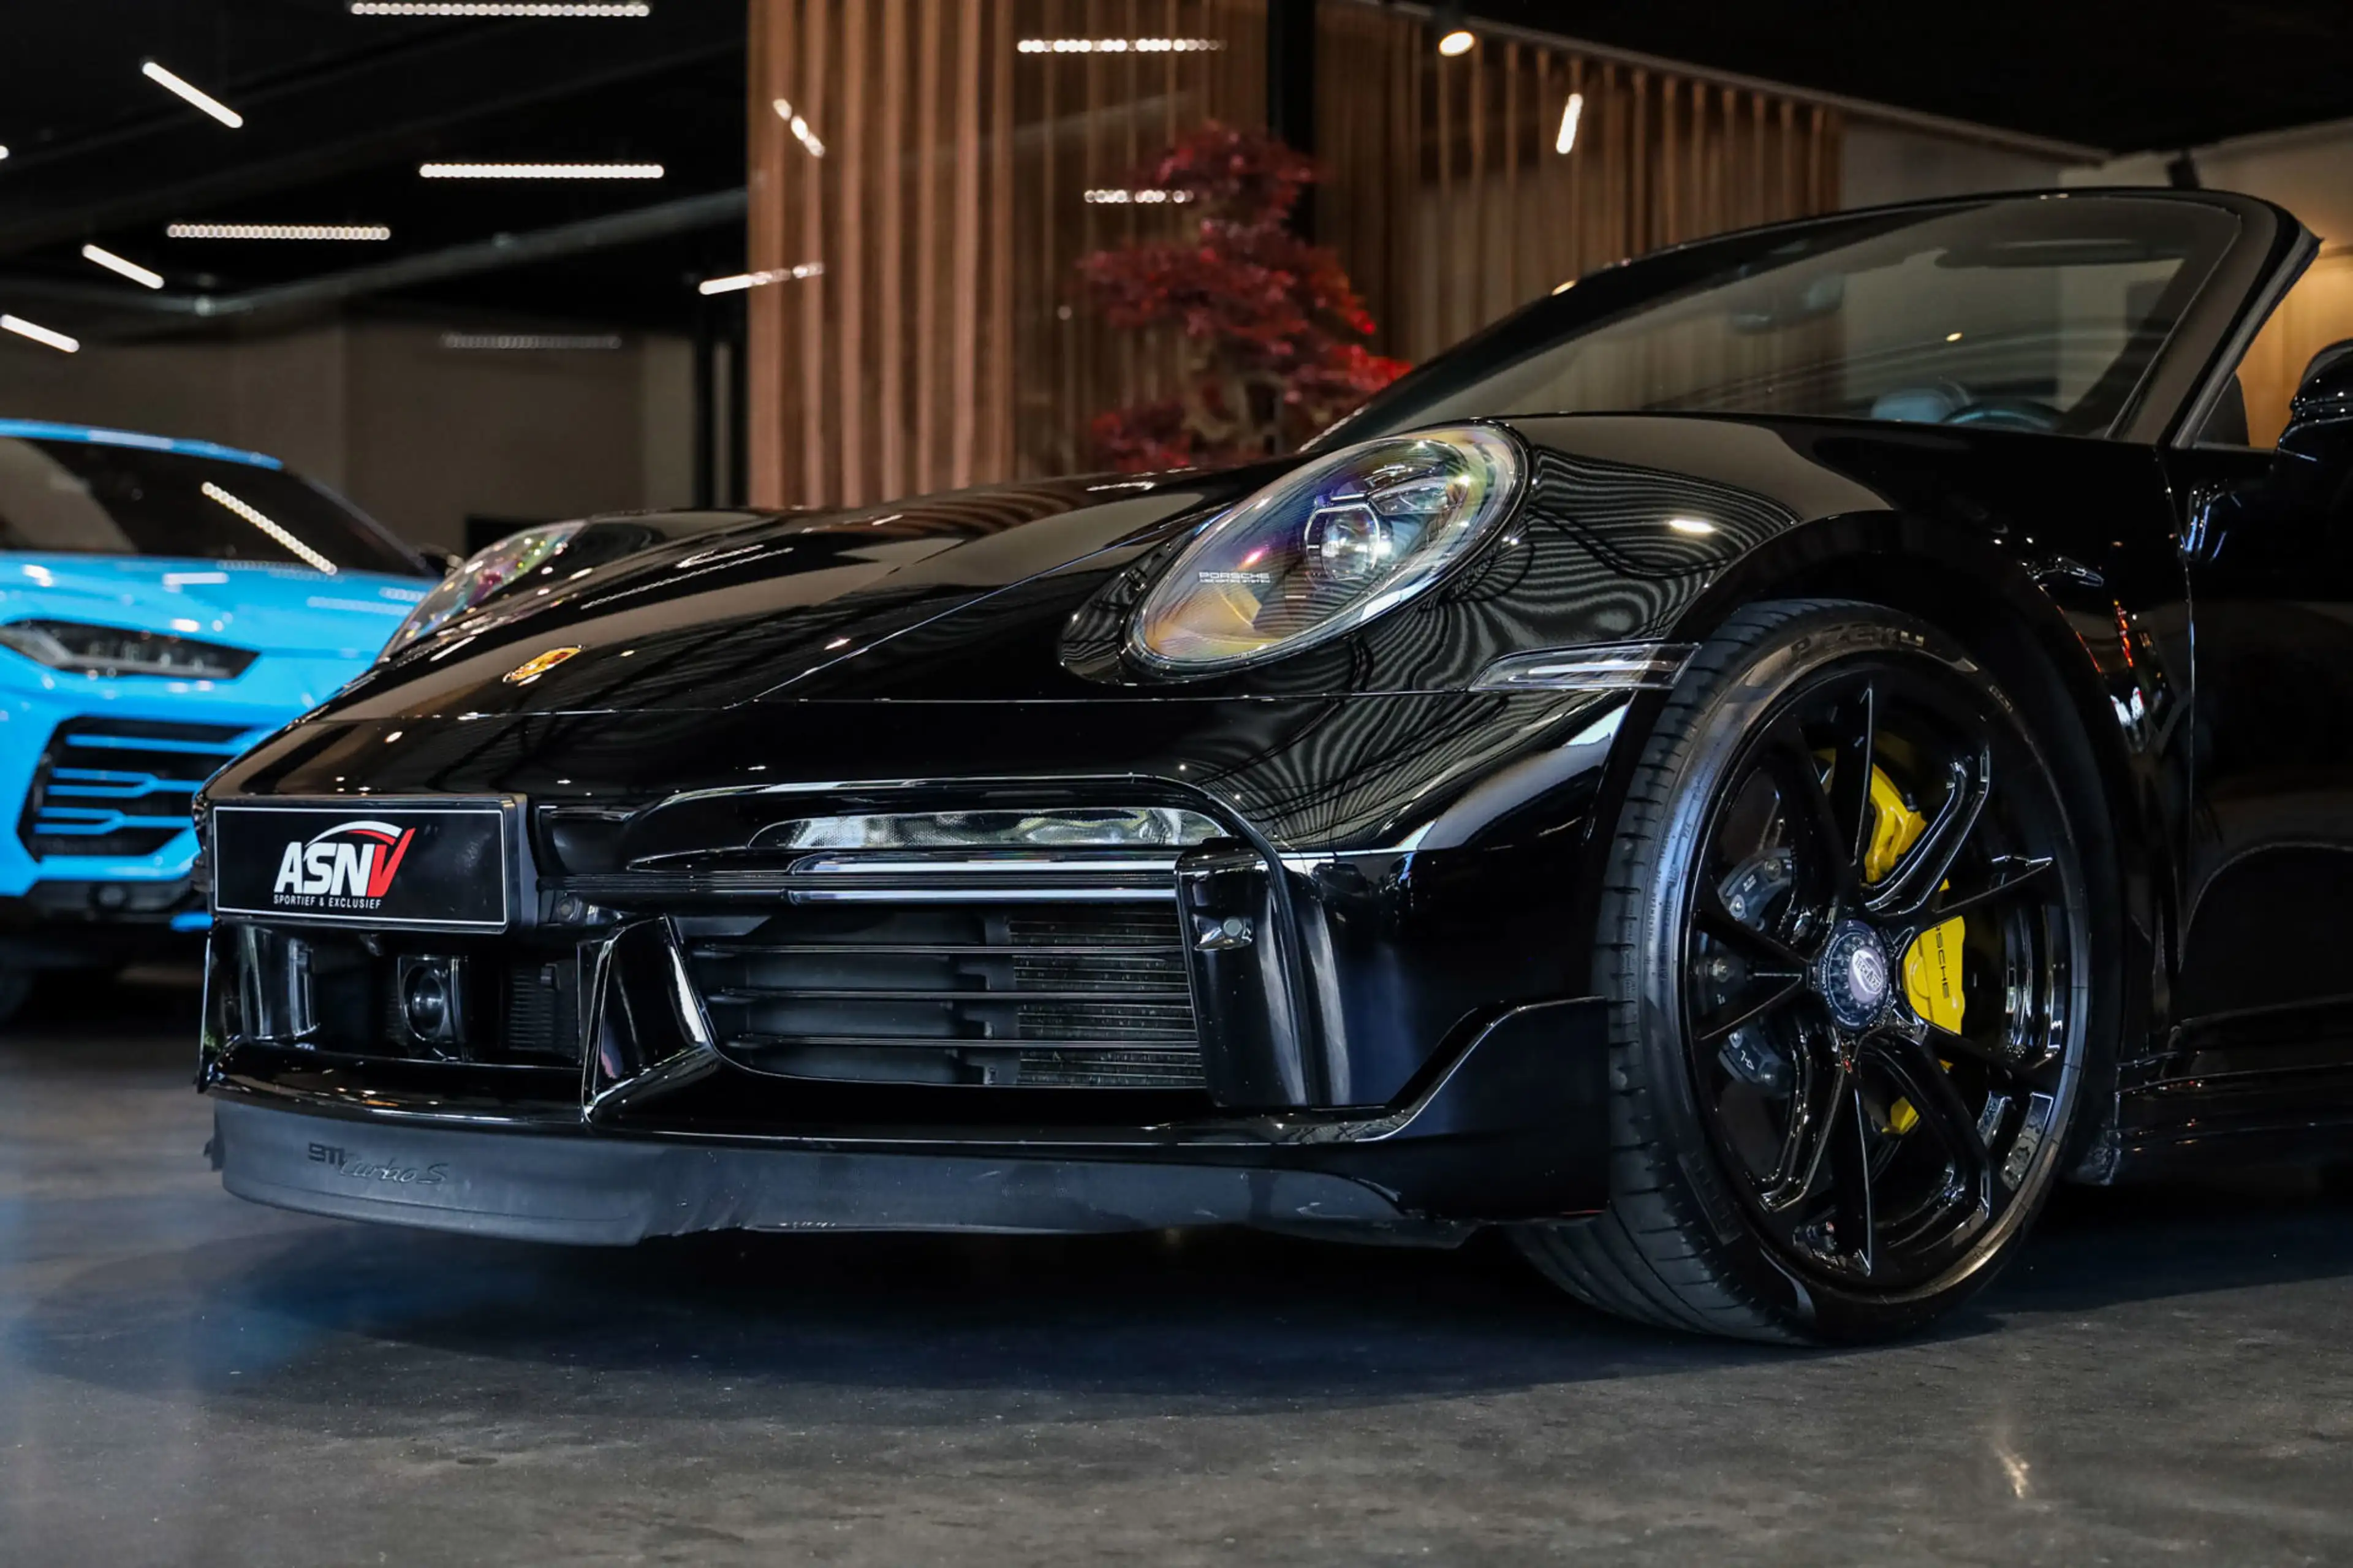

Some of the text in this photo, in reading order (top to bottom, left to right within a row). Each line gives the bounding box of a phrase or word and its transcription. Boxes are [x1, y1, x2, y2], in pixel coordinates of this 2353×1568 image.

[274, 827, 416, 898] ASNV
[273, 895, 382, 909] SPORTIEF & EXCLUSIEF
[417, 1164, 450, 1184] S
